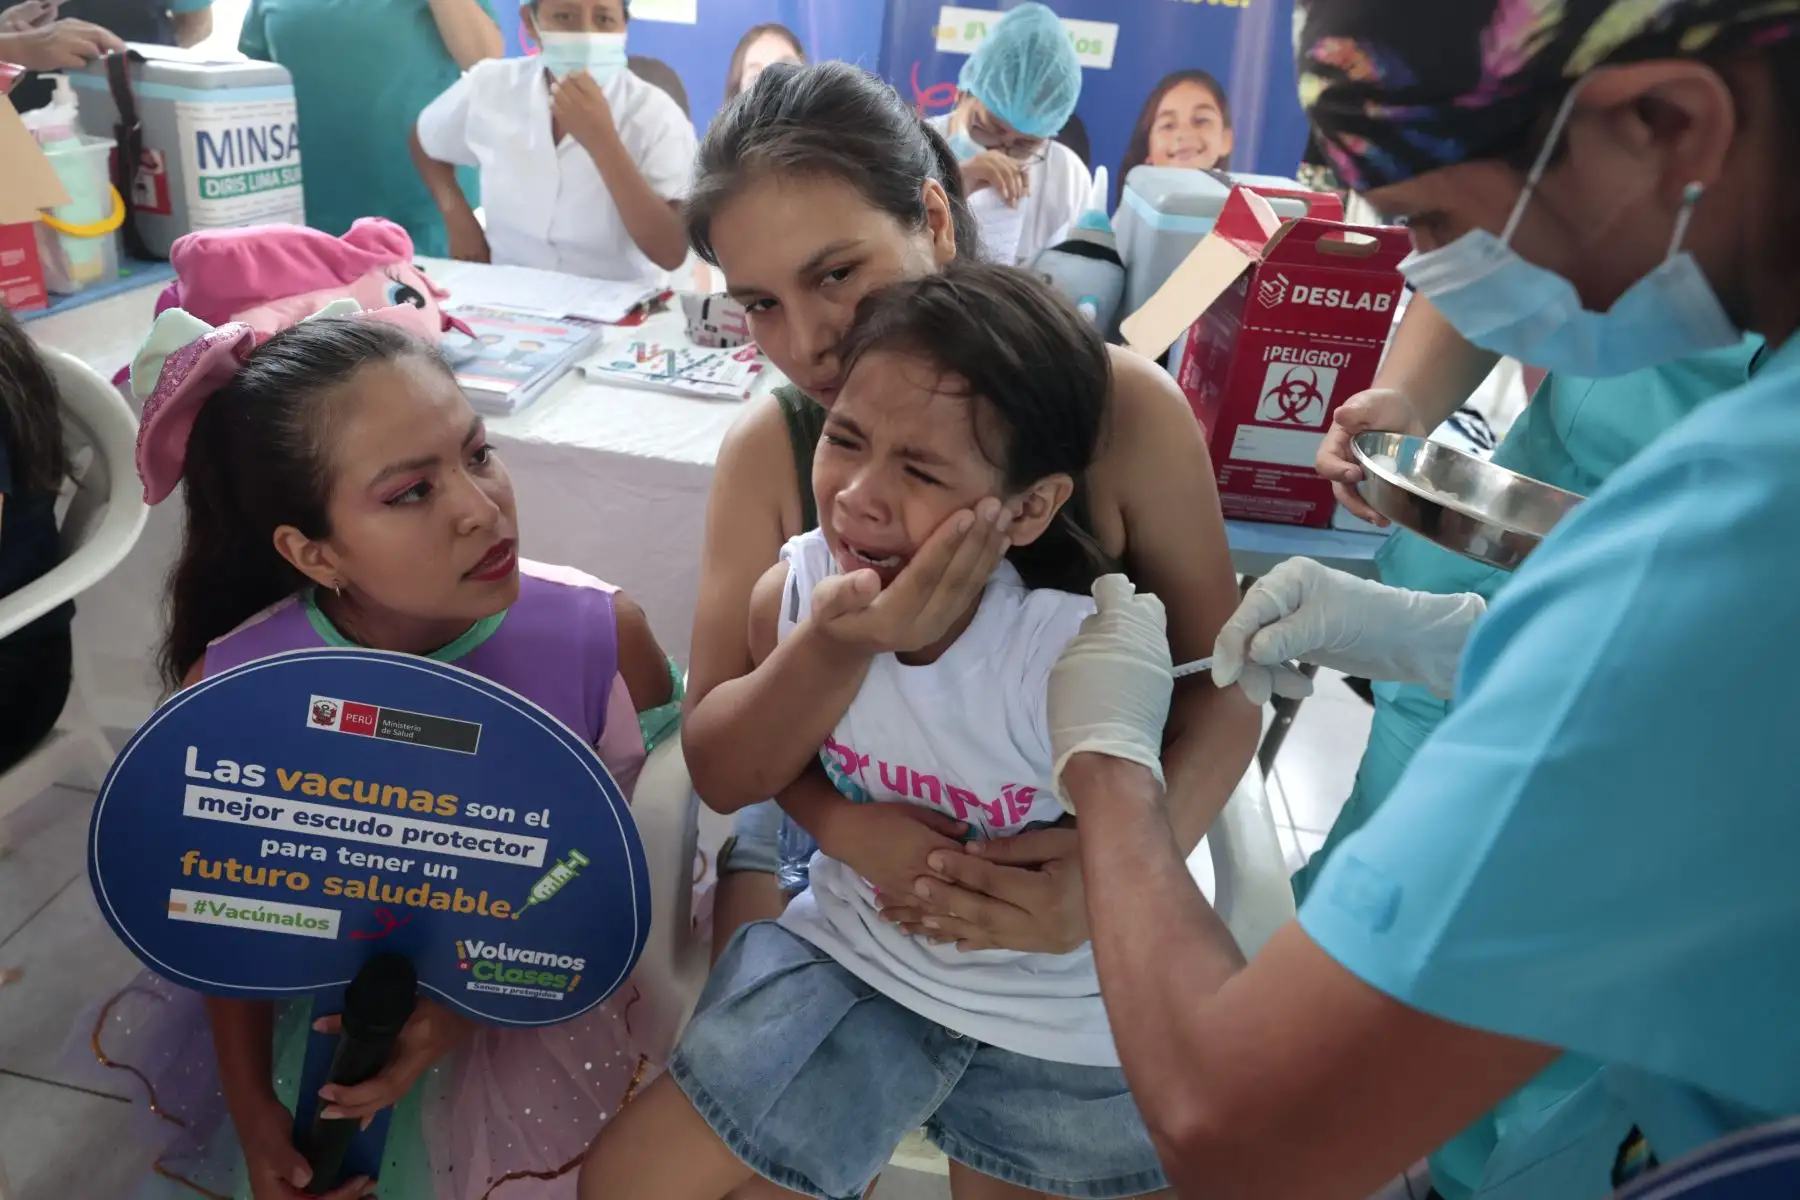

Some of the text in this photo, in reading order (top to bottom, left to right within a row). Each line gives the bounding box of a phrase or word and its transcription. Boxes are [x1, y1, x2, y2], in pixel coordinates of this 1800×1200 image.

[195, 122, 300, 170] MINSA
[1291, 285, 1392, 312] DESLAB
[1263, 345, 1352, 369] ¡PELIGRO!
[346, 713, 373, 726] PERÚ
[381, 727, 415, 739] de Salud
[382, 719, 422, 732] Ministerio
[184, 745, 551, 829] Las vacunas son el
[877, 759, 941, 805] un
[197, 795, 536, 860] mejor escudo protector
[260, 838, 459, 880] para tener un
[180, 850, 520, 920] futuro saludable.
[193, 899, 330, 931] #Vacúnalos
[472, 982, 501, 992] Sanos
[510, 988, 558, 999] protegidos
